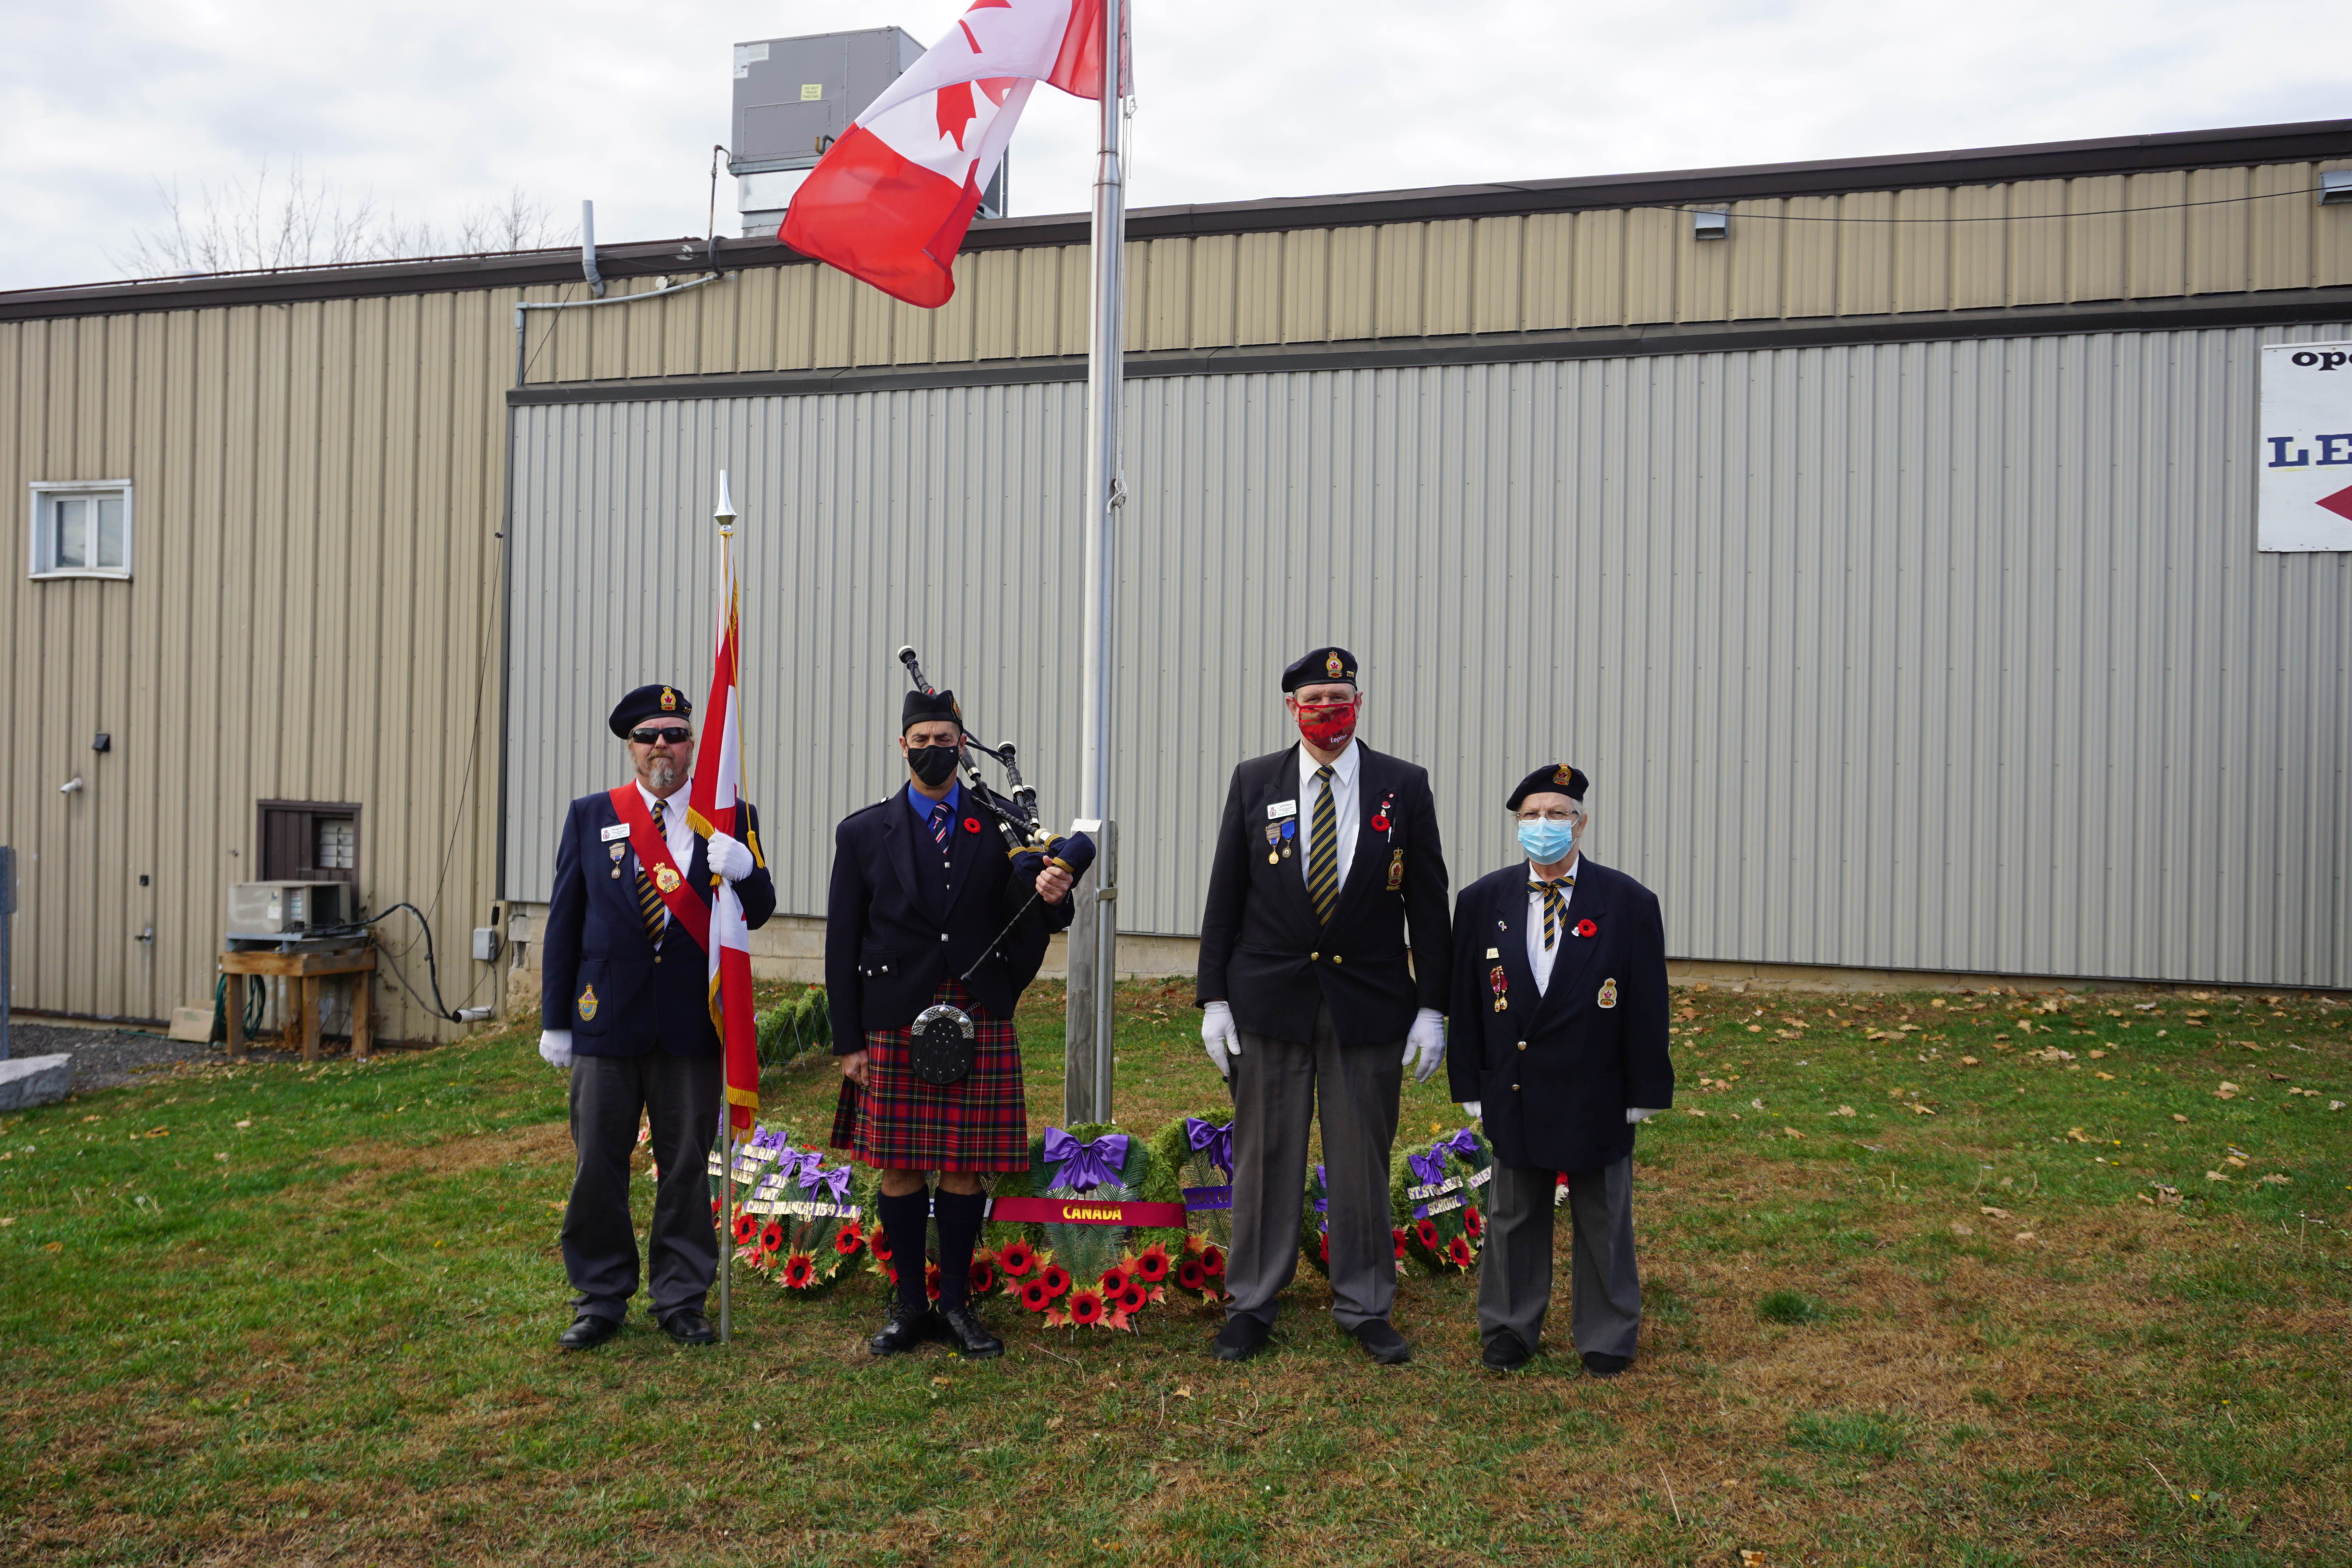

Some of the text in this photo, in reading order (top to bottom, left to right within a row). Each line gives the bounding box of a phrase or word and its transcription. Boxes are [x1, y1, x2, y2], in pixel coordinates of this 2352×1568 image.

[2292, 352, 2352, 371] op
[1330, 735, 1347, 743] Legion
[760, 1187, 780, 1201] ONT
[1218, 1191, 1230, 1203] OF
[746, 1201, 771, 1214] CRED
[773, 1201, 815, 1216] BRANCH
[814, 1203, 836, 1216] 159
[1063, 1204, 1122, 1220] CANADA
[1427, 1195, 1462, 1216] SCHOOL
